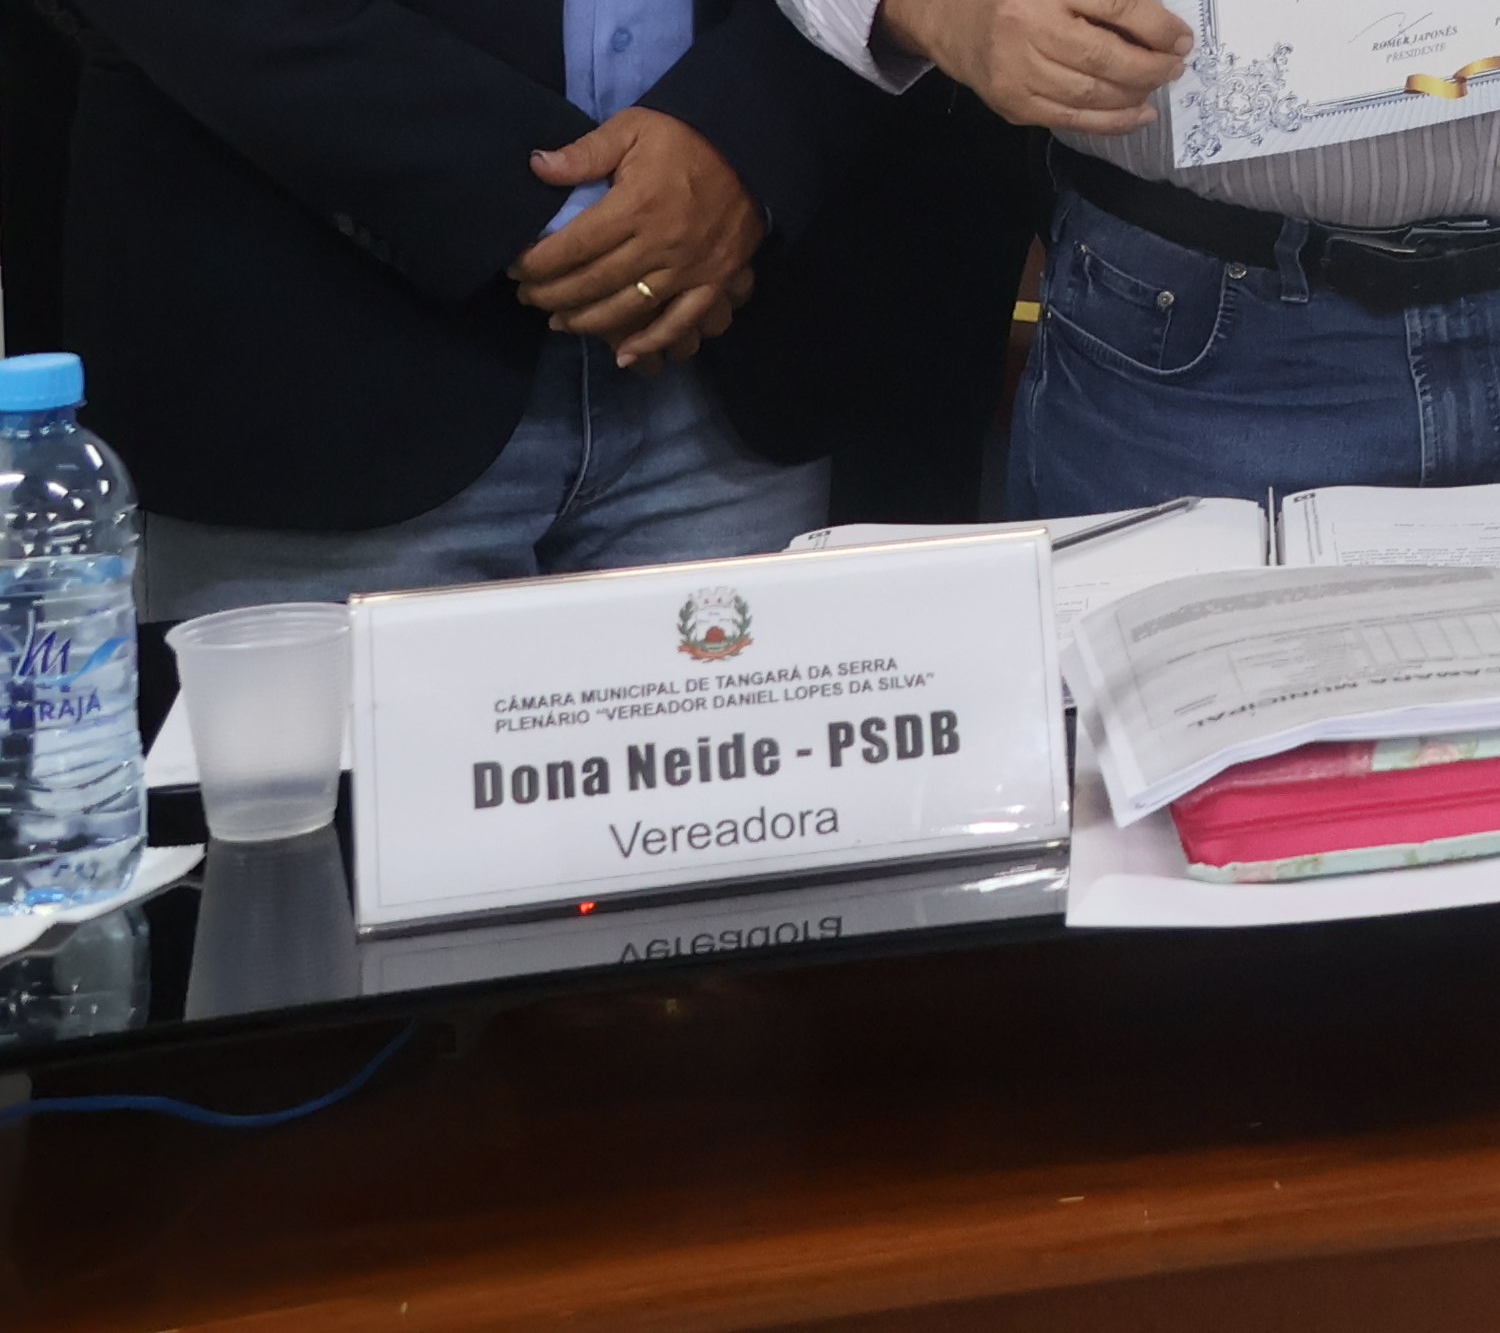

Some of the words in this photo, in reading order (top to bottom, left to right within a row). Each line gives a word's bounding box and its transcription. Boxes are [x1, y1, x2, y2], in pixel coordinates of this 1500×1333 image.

[494, 691, 574, 714] CÂMARA
[582, 680, 681, 704] MUNICIPAL
[686, 679, 710, 693] DE
[715, 663, 802, 689] TANGARÁ
[808, 665, 833, 678] DA
[838, 657, 898, 676] SERRA
[496, 709, 590, 733] PLENÁRIO
[713, 690, 779, 709] DANIEL
[784, 683, 844, 701] LOPES
[848, 679, 873, 694] DA
[473, 757, 610, 809] Dona
[627, 733, 780, 791] Neide
[828, 710, 960, 768] PSDB
[609, 806, 839, 859] Vereadora
